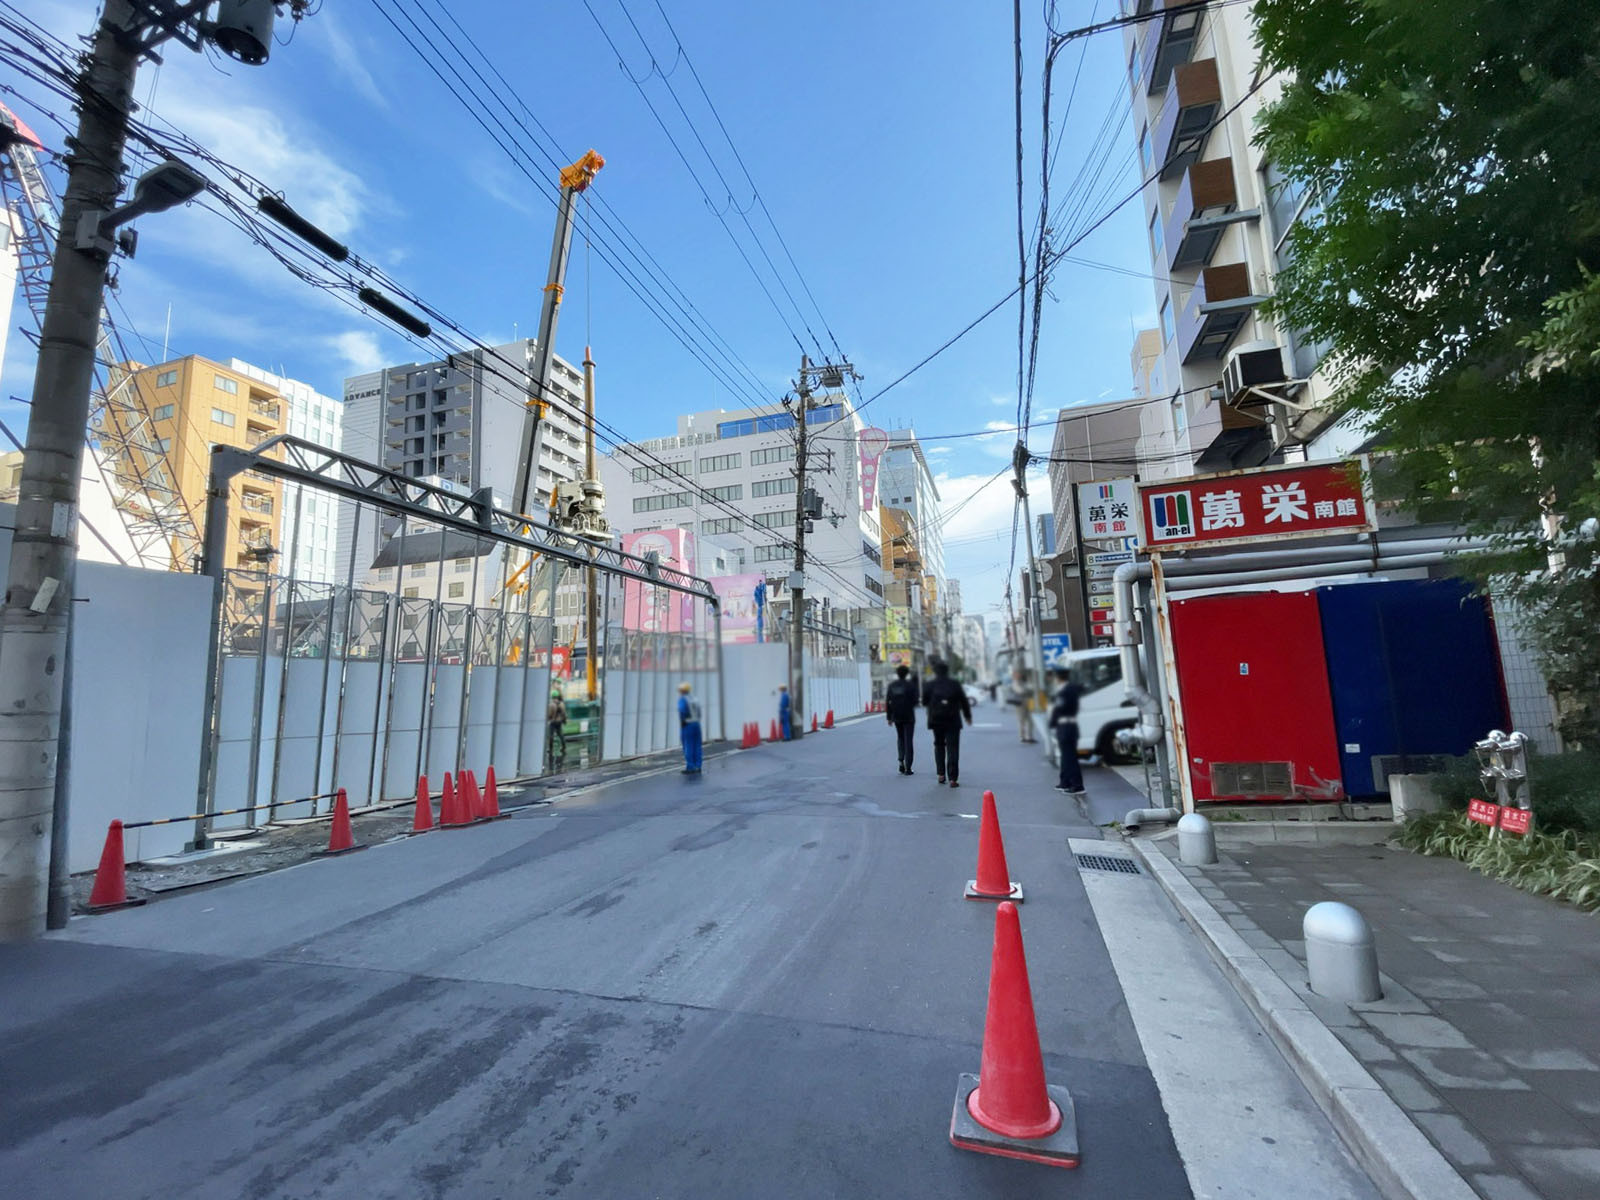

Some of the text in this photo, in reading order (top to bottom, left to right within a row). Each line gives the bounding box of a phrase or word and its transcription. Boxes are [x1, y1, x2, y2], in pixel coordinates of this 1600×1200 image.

[344, 389, 381, 401] ADVANCE
[1199, 481, 1358, 531] 萬栄 南館
[1088, 503, 1129, 522] 萬栄
[1093, 520, 1127, 534] 南館
[1088, 555, 1094, 564] 8
[1089, 570, 1095, 578] 7
[1091, 584, 1097, 592] 6
[1092, 597, 1099, 606] 5
